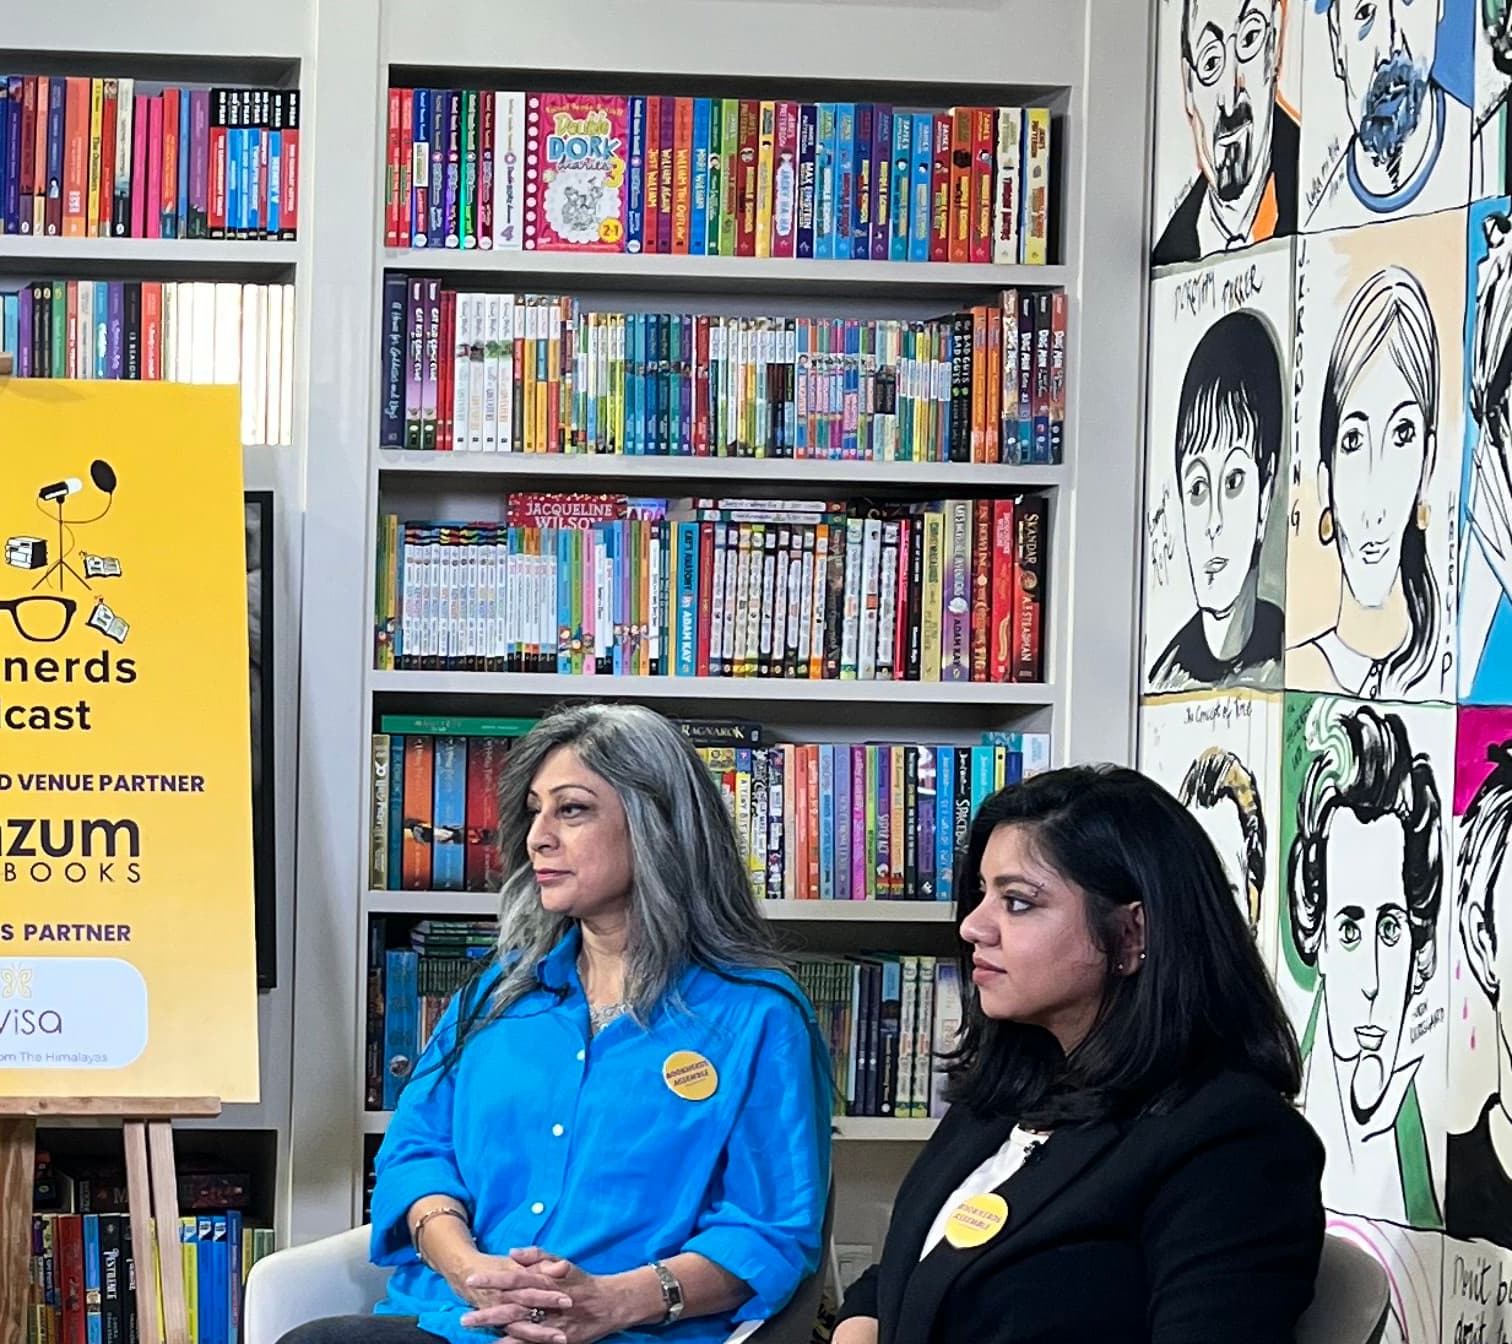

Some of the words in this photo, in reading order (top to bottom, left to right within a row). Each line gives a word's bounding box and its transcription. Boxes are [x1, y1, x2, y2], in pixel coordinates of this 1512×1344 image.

[548, 136, 620, 161] DORK
[525, 503, 613, 516] JACQUELINE
[1024, 513, 1040, 566] SKANDAR
[682, 610, 692, 640] ADAM
[682, 642, 692, 664] KAY
[680, 723, 745, 741] RAGNAROK
[17, 773, 95, 793] VENUE
[99, 774, 205, 793] PARTNER
[4, 862, 142, 884] BOOKS
[24, 922, 131, 942] PARTNER
[20, 1049, 42, 1063] The
[44, 1049, 108, 1063] Himalayas
[103, 1248, 120, 1301] PESTILENCE
